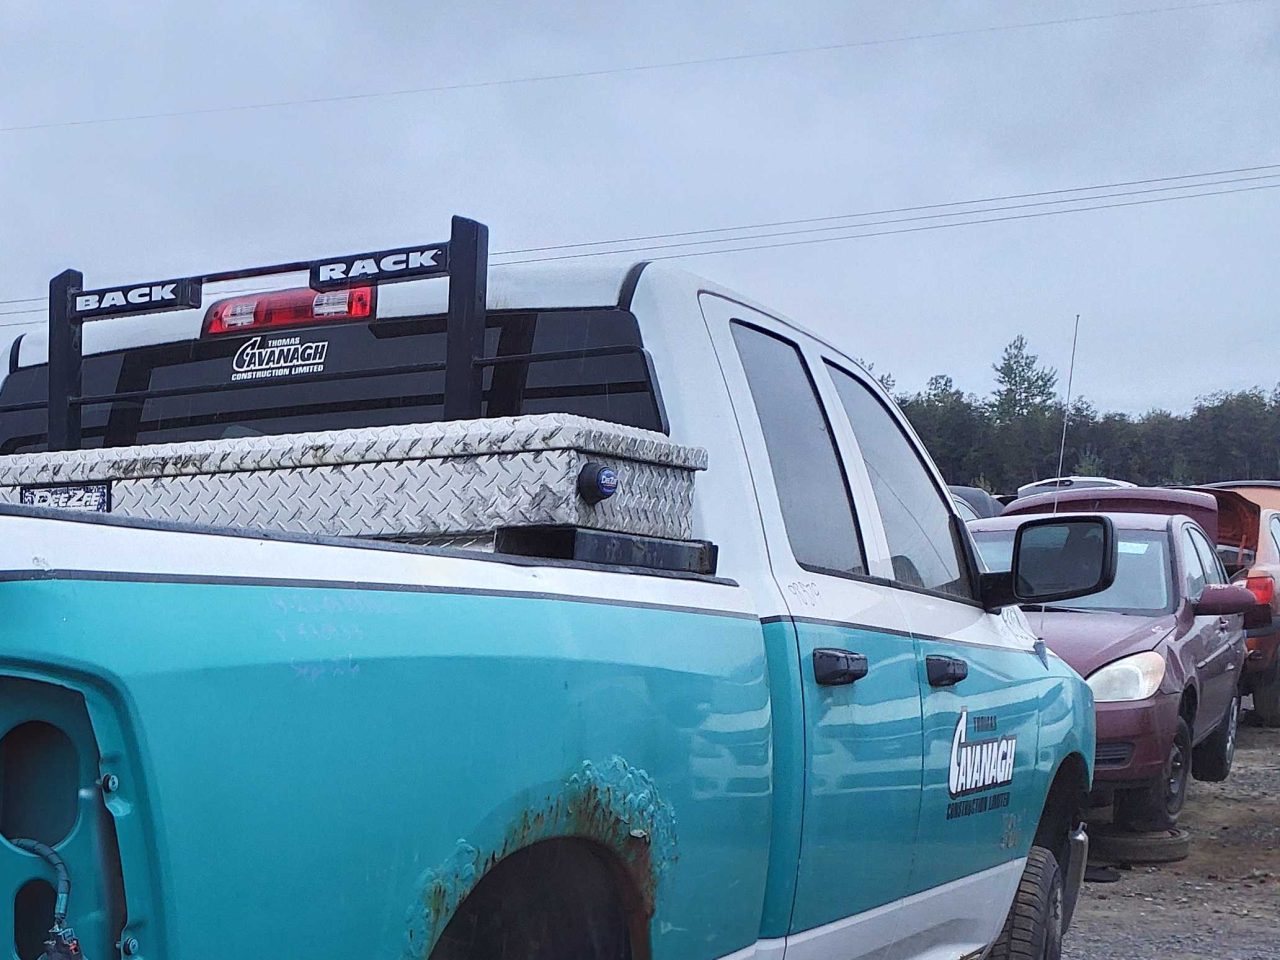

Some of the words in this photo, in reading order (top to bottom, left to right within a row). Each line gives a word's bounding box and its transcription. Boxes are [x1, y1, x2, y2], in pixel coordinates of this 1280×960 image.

[76, 283, 177, 312] BACK
[320, 249, 439, 281] RACK
[232, 336, 328, 372] CAVANAGH
[268, 337, 300, 347] THOMAS
[231, 367, 290, 381] CONSTRUCTION
[291, 364, 324, 375] LIMITED
[949, 706, 1017, 800] CAVANAGH
